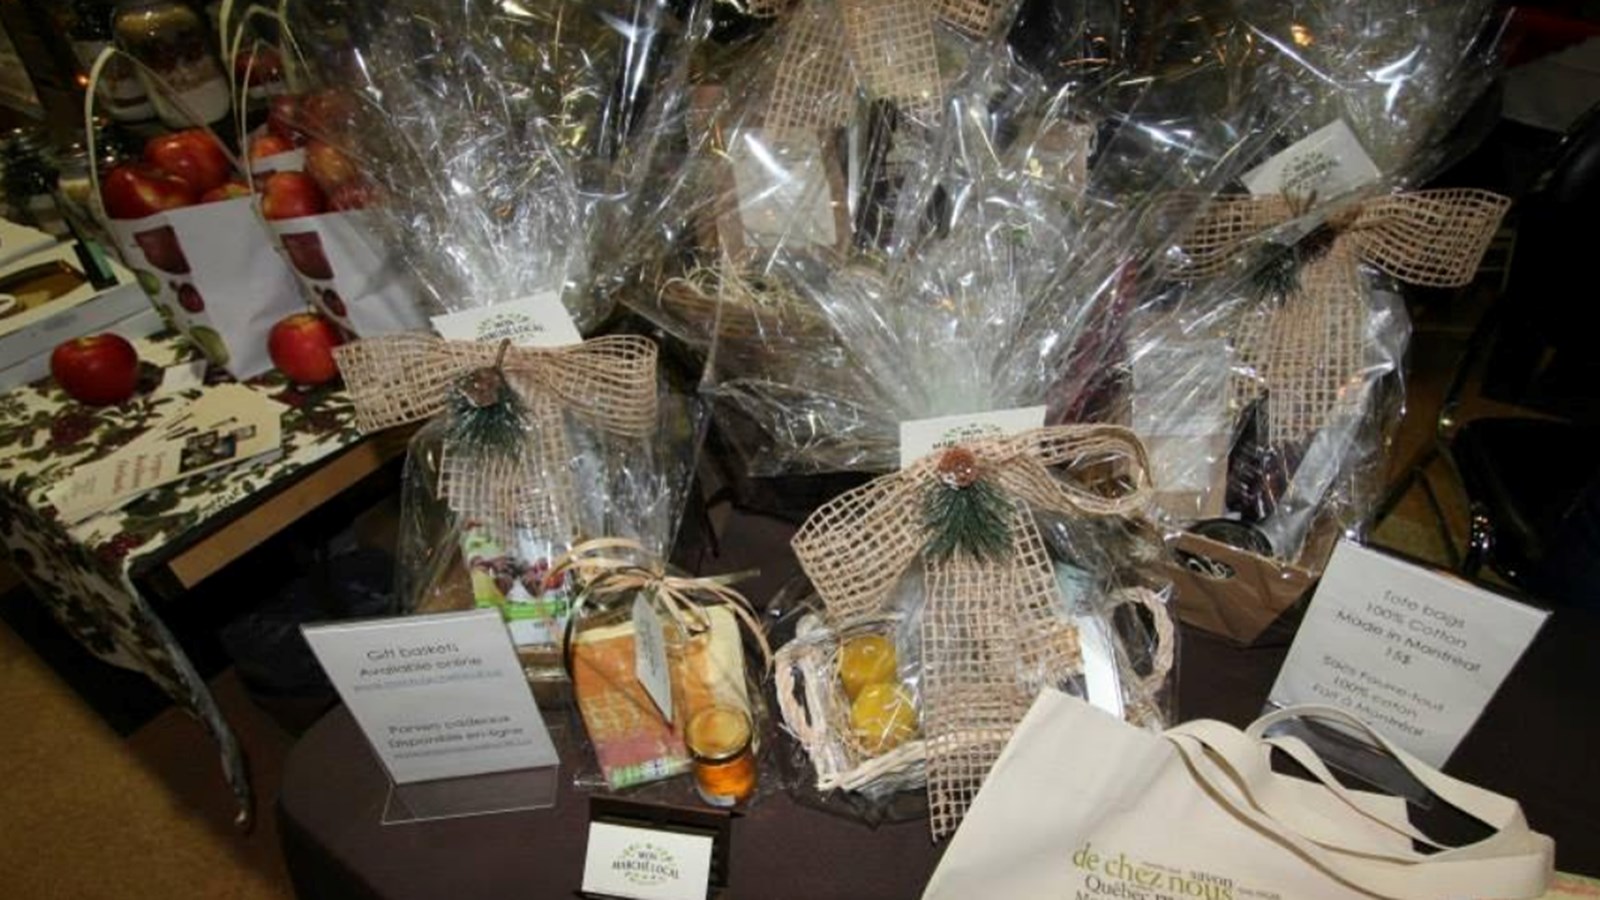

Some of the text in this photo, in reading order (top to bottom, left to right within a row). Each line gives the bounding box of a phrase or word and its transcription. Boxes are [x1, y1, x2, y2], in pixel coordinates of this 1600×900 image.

[1336, 610, 1383, 635] Made
[1387, 630, 1402, 643] in
[1367, 603, 1467, 648] 100% Cotton
[1422, 606, 1465, 628] bags
[367, 643, 459, 661] Gift baskets
[1386, 647, 1411, 665] 15$
[359, 657, 482, 678] Available online
[1334, 676, 1369, 698] 100%
[638, 850, 657, 860] MON
[612, 859, 679, 880] MARCHÉ LOCAL
[1072, 842, 1099, 871] de
[1104, 853, 1163, 888] chez
[1168, 874, 1234, 900] nous
